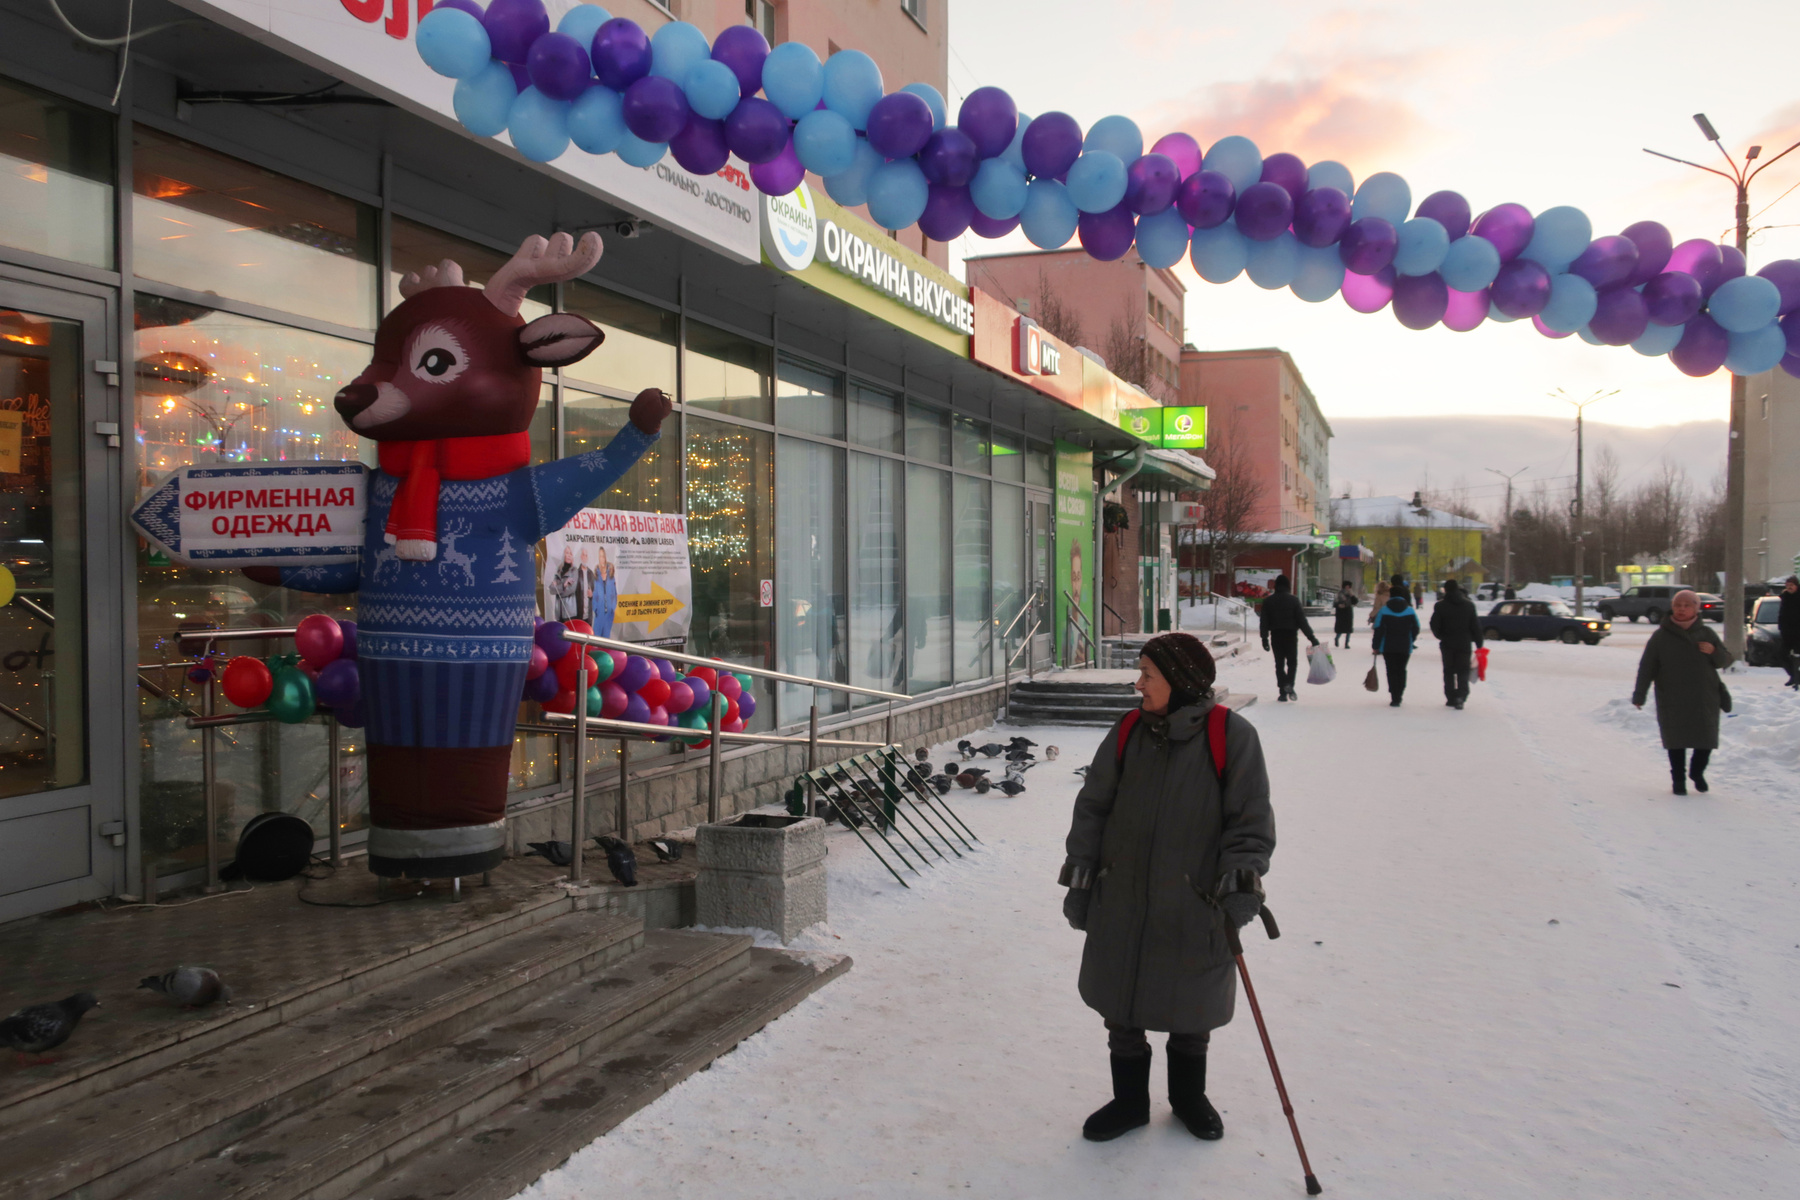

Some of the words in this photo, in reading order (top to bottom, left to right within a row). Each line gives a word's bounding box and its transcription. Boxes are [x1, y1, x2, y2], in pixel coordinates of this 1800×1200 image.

[656, 162, 700, 197] СТИЛЬНО
[704, 189, 752, 223] ДОСТУПНО
[770, 196, 814, 232] ОКРАИНА
[823, 220, 911, 302] ОКРАИНА
[913, 270, 975, 336] ВКУСНЕЕ
[1042, 344, 1061, 375] МТС
[184, 487, 355, 511] ФИРМЕННАЯ
[211, 513, 332, 538] ОДЕЖДА
[629, 515, 685, 535] ВЫСТАВКА
[565, 534, 595, 543] ЗАКРЫТИЕ
[595, 535, 629, 545] МАГАЗИНОВ
